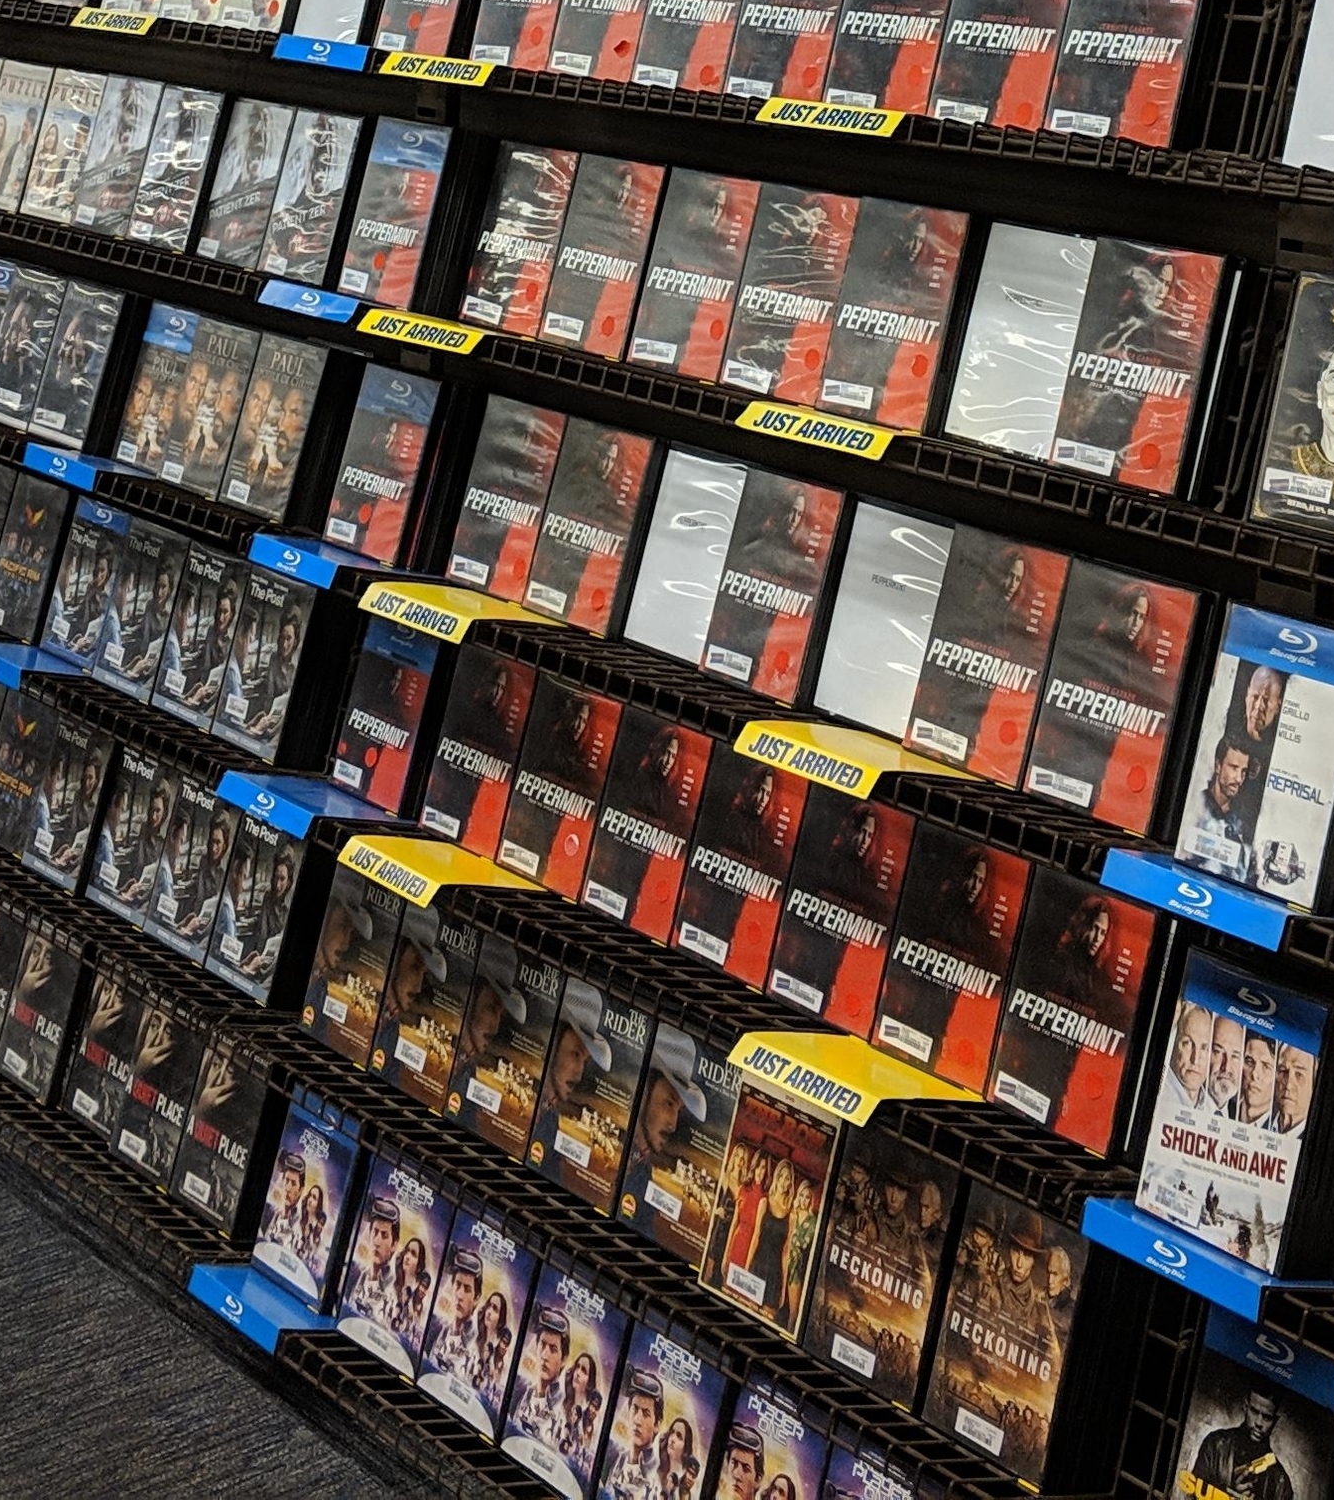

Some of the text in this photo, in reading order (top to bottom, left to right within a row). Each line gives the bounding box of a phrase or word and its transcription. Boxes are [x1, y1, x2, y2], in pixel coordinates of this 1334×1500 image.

[80, 12, 147, 31] JUST ARRIVED
[840, 10, 940, 44] PEPPERMINT
[1064, 29, 1183, 63] PEPPERMINT
[0, 77, 45, 99] PUZZLE
[771, 103, 888, 131] JUST ARRIVED
[559, 246, 637, 282] PEPPERMINT
[837, 304, 940, 344] PEPPERMINT
[208, 333, 239, 360] PAUL
[271, 352, 304, 377] PAUL
[1070, 351, 1191, 398] PEPPERMINT
[753, 410, 874, 451] JUST ARRIVED
[341, 466, 406, 501] PEPPERMINT
[543, 511, 624, 557] PEPPERMINT
[251, 584, 284, 609] The Post
[370, 591, 457, 636] JUST ARRIVED
[720, 570, 814, 618] PEPPERMINT
[926, 638, 1037, 693] PEPPERMINT
[437, 736, 512, 784] PEPPERMINT
[749, 733, 863, 789] JUST ARRIVED
[1267, 772, 1325, 806] REPRISAL
[245, 816, 279, 847] The Post
[348, 847, 427, 899] JUST ARRIVED
[787, 889, 887, 949] PEPPERMINT
[519, 964, 559, 998] RIDER
[544, 964, 559, 980] THE
[9, 997, 16, 1015] A
[35, 1013, 62, 1047] PLACE
[604, 1009, 647, 1044] RIDER
[629, 1008, 647, 1026] THE
[1009, 988, 1125, 1056] PEPPERMINT
[744, 1045, 862, 1117] JUST ARRIVED
[186, 1114, 194, 1136] A
[218, 1135, 248, 1169] PLACE
[1161, 1124, 1288, 1184] SHOCK AND AWE
[830, 1243, 923, 1310] RECKONING
[950, 1310, 1053, 1382] RECKONING
